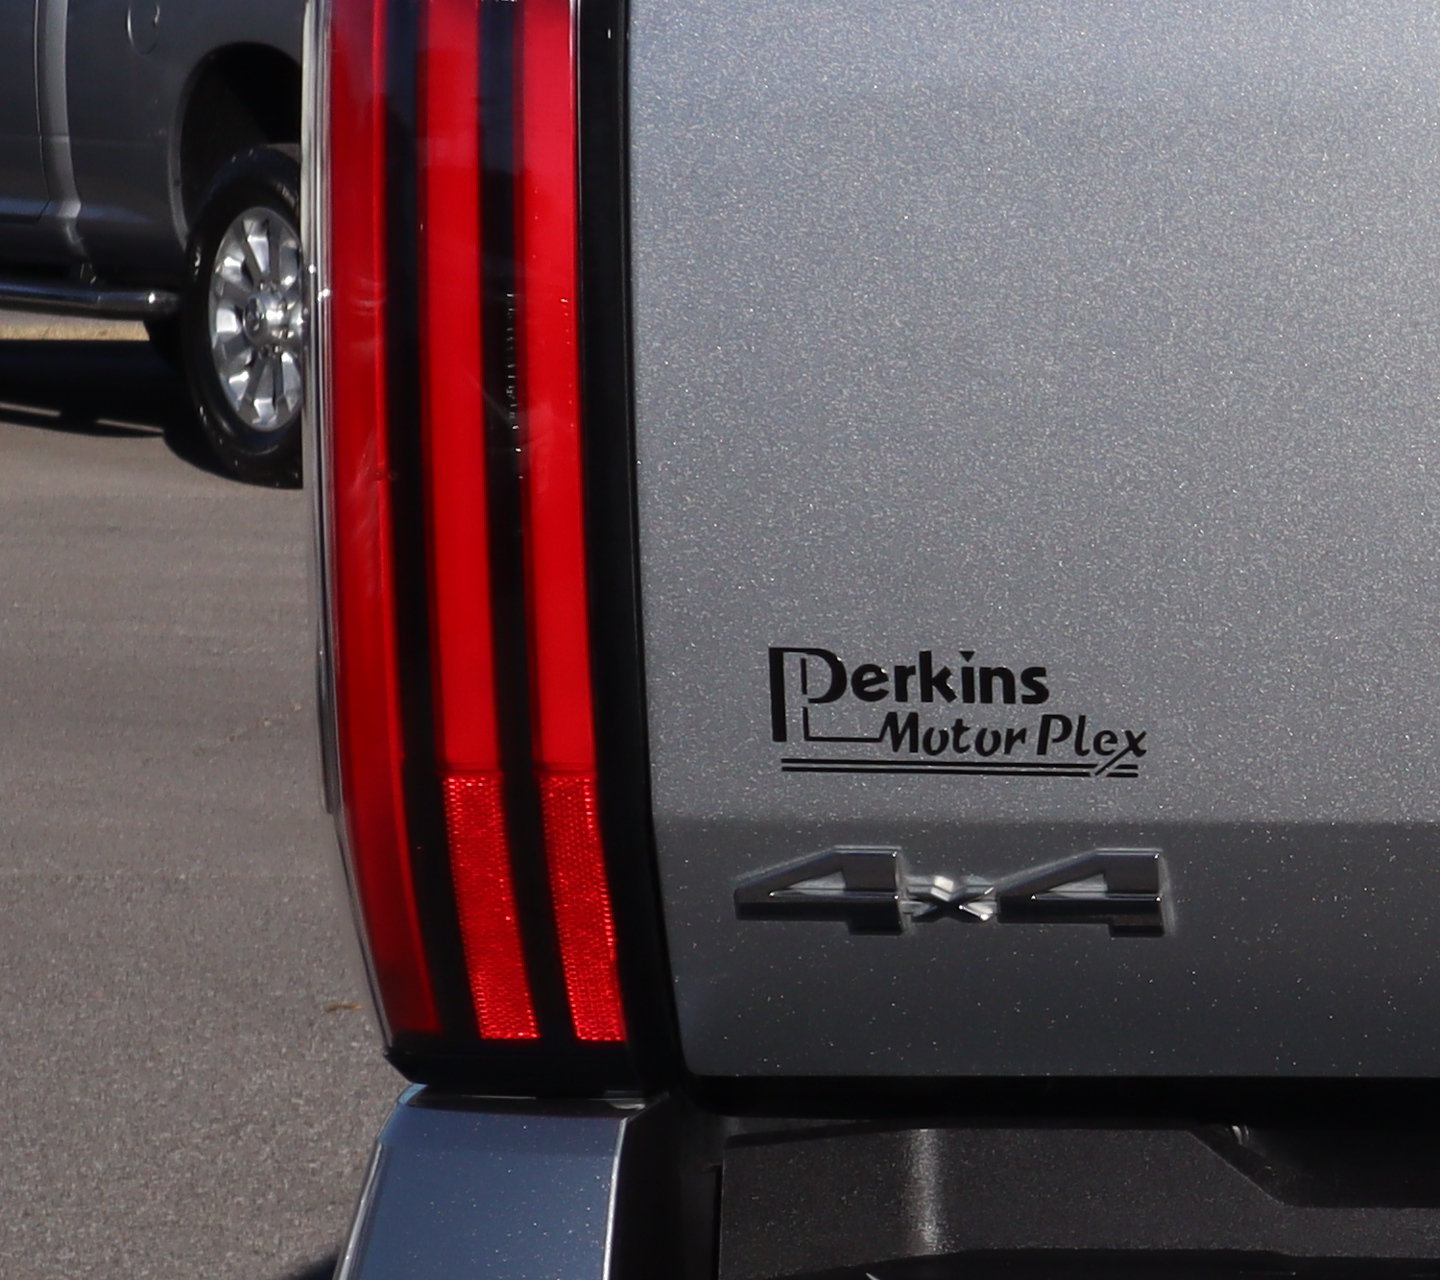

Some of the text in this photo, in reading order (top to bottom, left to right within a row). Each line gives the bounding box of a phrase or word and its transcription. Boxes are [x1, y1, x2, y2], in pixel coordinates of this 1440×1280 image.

[768, 647, 1050, 742] Perkins
[880, 711, 1148, 776] Motor Plex
